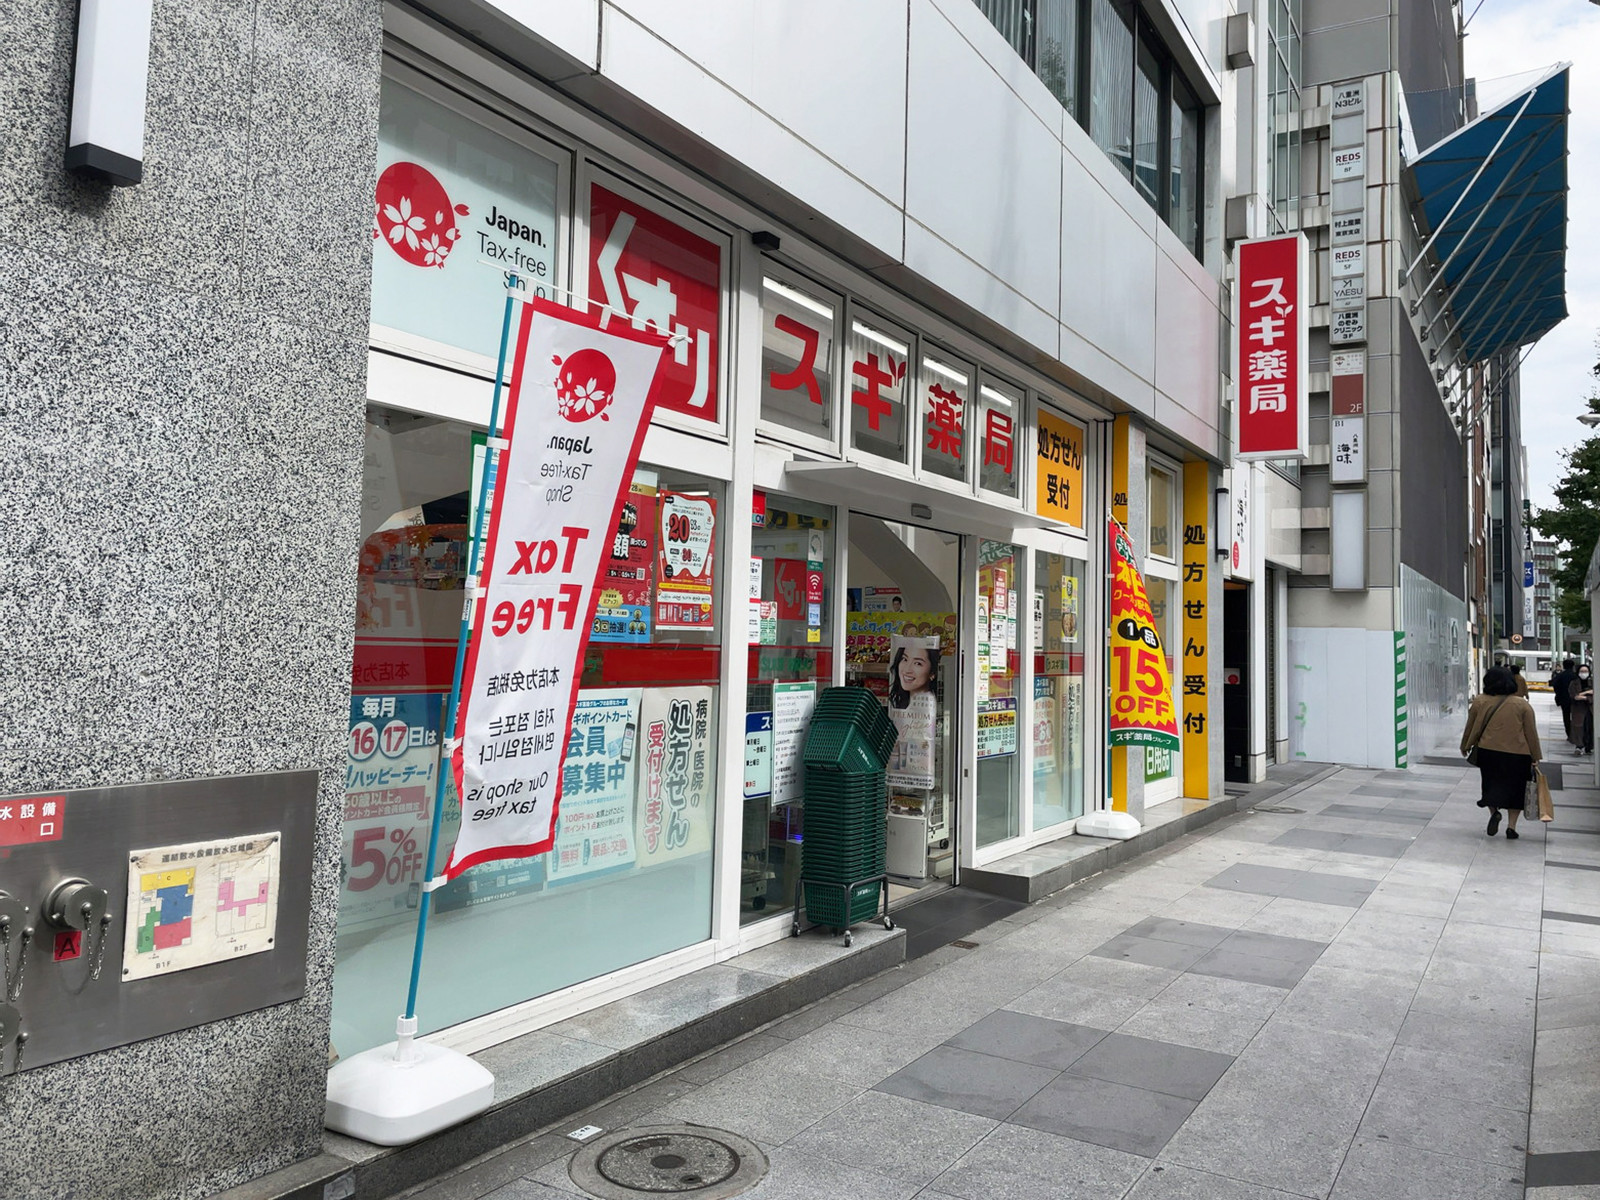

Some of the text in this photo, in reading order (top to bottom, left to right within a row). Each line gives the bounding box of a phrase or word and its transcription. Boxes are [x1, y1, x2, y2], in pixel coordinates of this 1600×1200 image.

[1334, 99, 1361, 108] N3ビル
[1335, 152, 1361, 163] REDS
[485, 206, 547, 248] Japan.
[476, 231, 547, 277] Tax-free
[1335, 250, 1361, 260] REDS
[503, 271, 547, 302] Shp
[1334, 287, 1363, 299] YAESU
[1333, 325, 1363, 335] クリニック
[1249, 277, 1294, 415] スギ薬局
[770, 314, 1013, 474] スギ薬局
[1350, 403, 1362, 413] 2F
[1037, 424, 1082, 472] 処方せん
[1046, 474, 1071, 510] 受付
[1184, 524, 1206, 735] 処方せん受付
[362, 697, 396, 718] 毎月
[571, 710, 632, 725] ギポイントカード
[1115, 694, 1170, 717] OFF
[761, 716, 773, 730] ス
[351, 727, 375, 755] 16
[383, 725, 407, 752] 17
[567, 726, 606, 760] 会員
[690, 699, 708, 809] 病院・医院の
[562, 760, 626, 798] 募集中
[644, 722, 665, 851] 受付けます
[666, 701, 693, 848] 処方せん
[0, 802, 56, 820] 水設備
[386, 853, 423, 886] OFF
[59, 937, 76, 957] A
